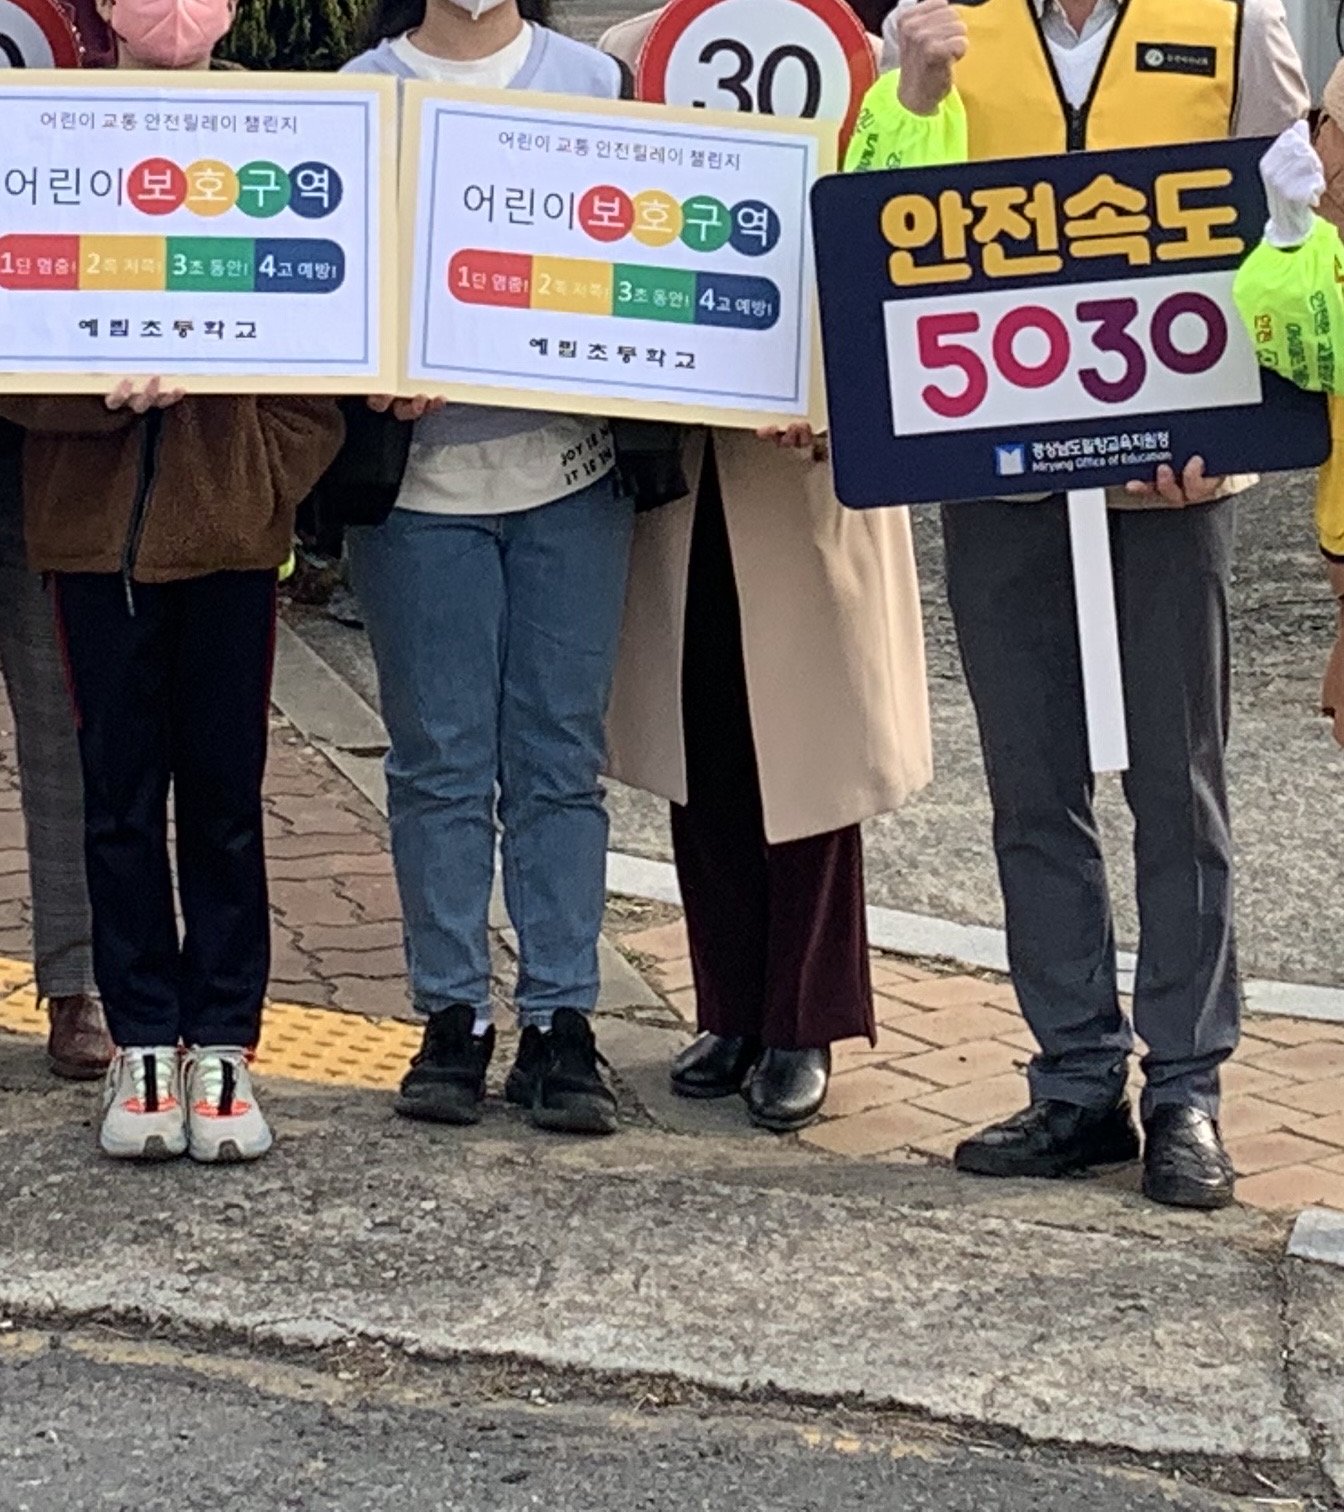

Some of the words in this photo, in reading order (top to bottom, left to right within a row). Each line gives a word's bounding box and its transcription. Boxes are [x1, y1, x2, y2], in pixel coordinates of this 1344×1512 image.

[692, 38, 822, 119] 30
[40, 111, 96, 130] 어린이
[101, 113, 138, 131] 교통
[144, 113, 238, 133] 안전릴레이
[243, 115, 298, 135] 챌린지
[498, 131, 550, 153] 어린이
[555, 137, 590, 157] 교통
[689, 149, 741, 171] 챌린지
[4, 165, 331, 208] 어린이보호구역
[463, 184, 769, 248] 어린이보호구역
[880, 168, 1245, 287] 안전속도
[916, 290, 1229, 419] 5030
